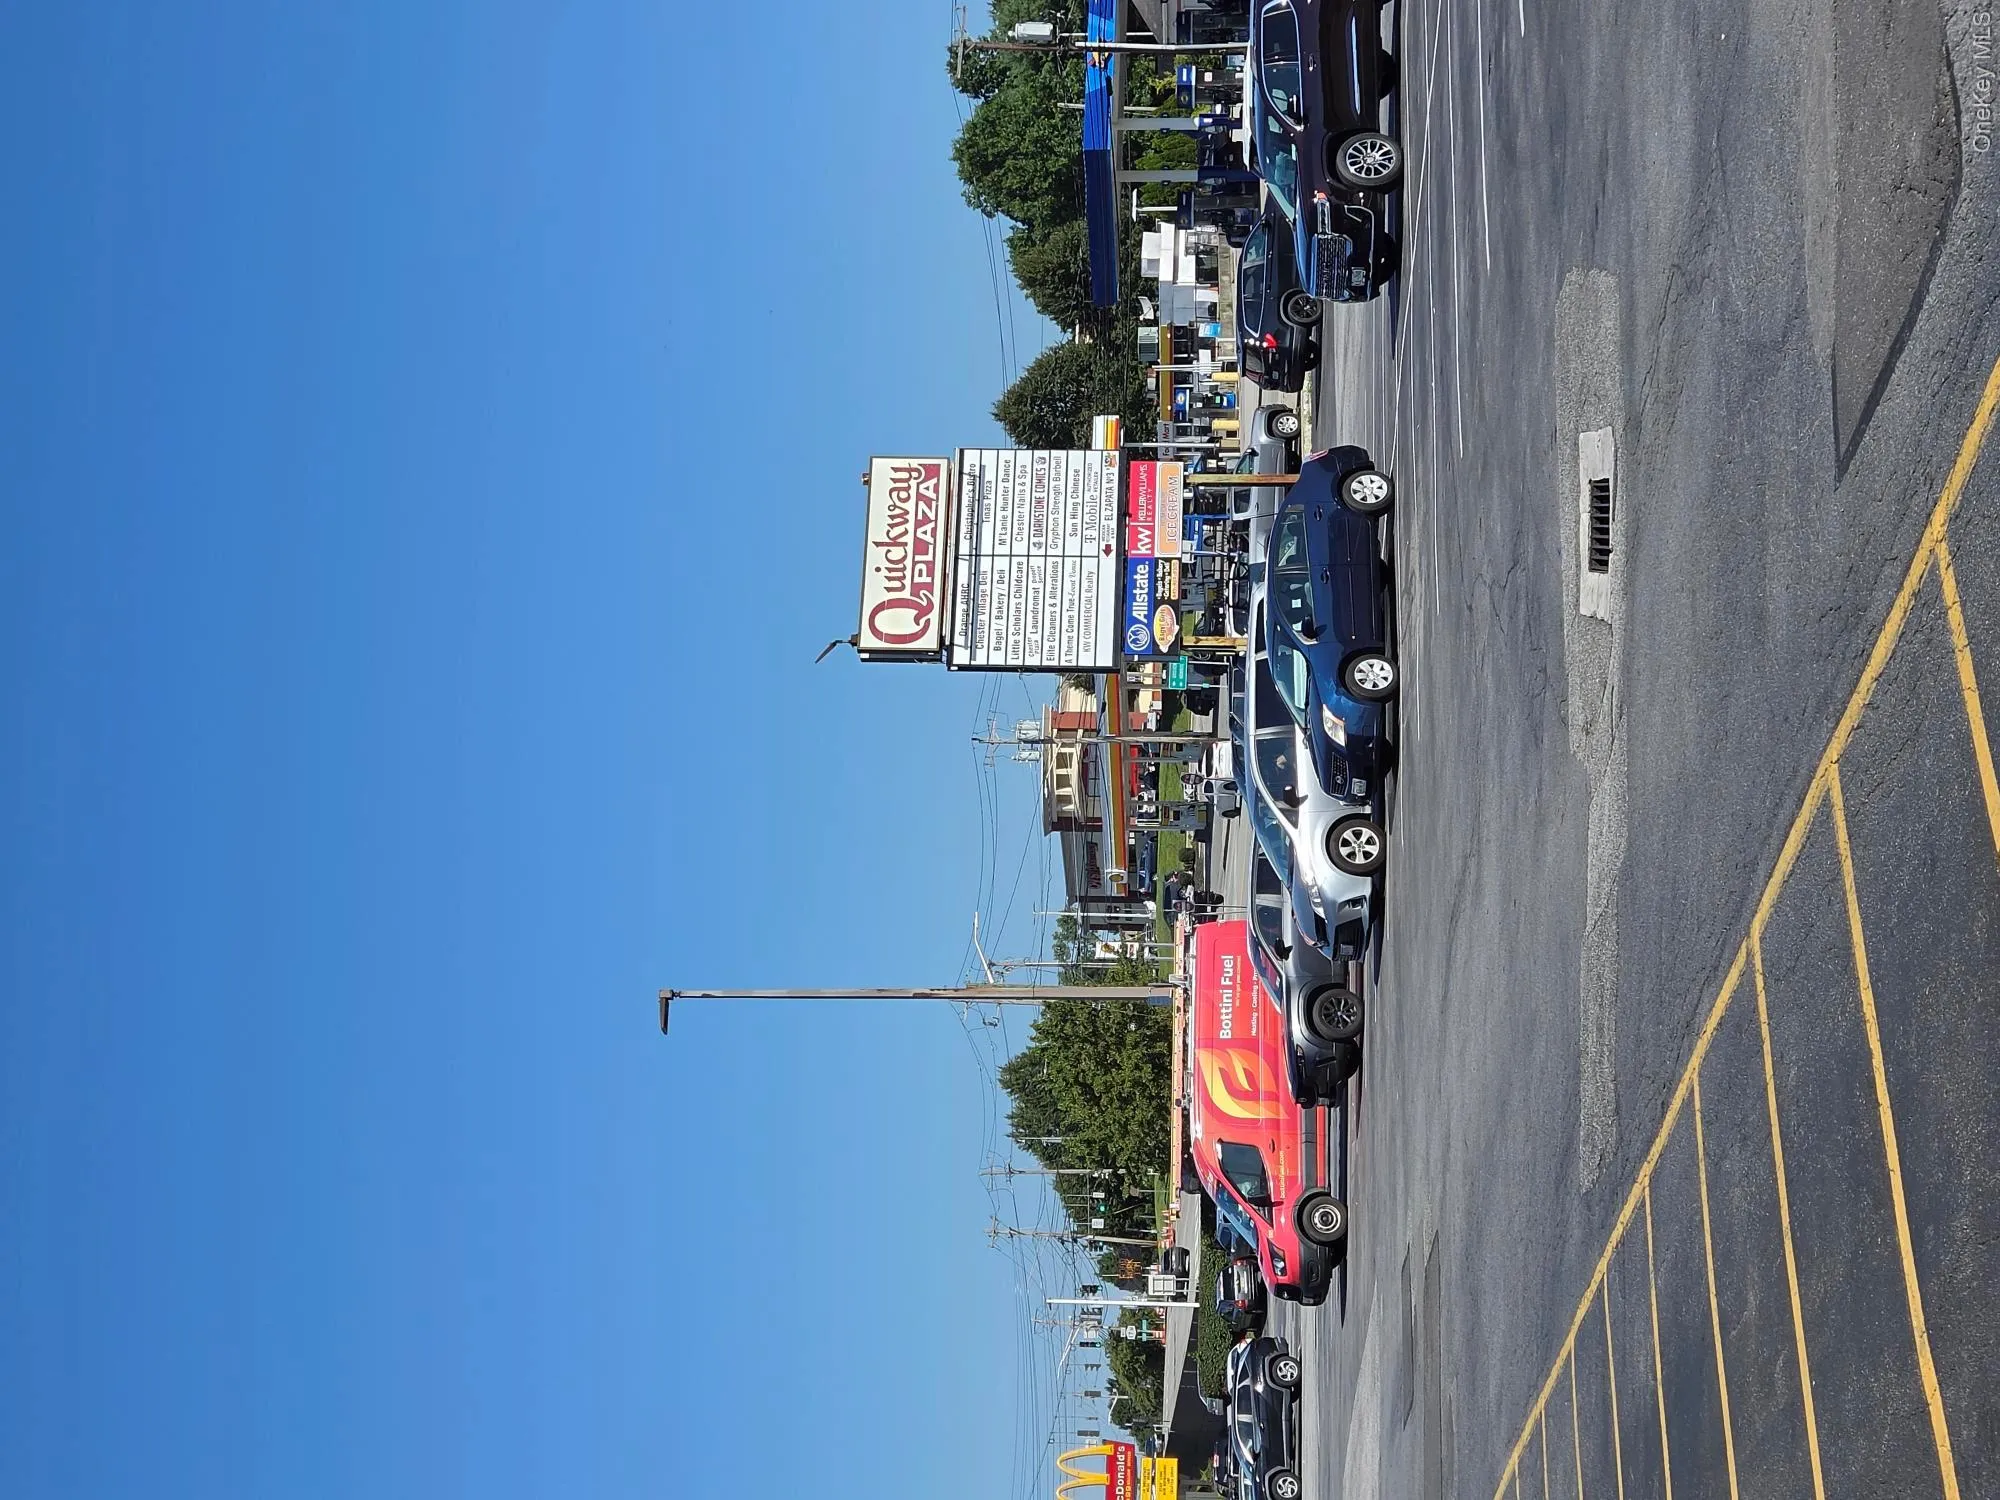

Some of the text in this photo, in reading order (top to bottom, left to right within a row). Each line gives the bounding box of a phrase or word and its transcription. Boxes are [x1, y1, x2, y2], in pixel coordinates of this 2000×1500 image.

[983, 480, 992, 500] Pizza
[1018, 464, 1028, 480] Spa
[998, 459, 1011, 546] M'Lanie Hunter Dance
[1016, 488, 1026, 508] Nails
[1033, 467, 1046, 538] DARKSTONE COMICS
[1050, 456, 1062, 550] Gryphon Strength Barbell
[1069, 468, 1080, 538] Sun Hing Chinese
[1085, 494, 1098, 531] Mobile
[1104, 513, 1113, 521] EL
[1105, 486, 1114, 512] ZAPATA
[1167, 476, 1178, 542] ICE CREAM
[914, 476, 938, 584] PLAZA
[1014, 510, 1024, 542] Chester
[1130, 526, 1152, 554] kw
[868, 462, 934, 644] Quickway
[996, 569, 1006, 584] Deli
[1049, 560, 1058, 600] Alterations
[958, 583, 970, 636] Orange AHRC
[976, 570, 988, 650] Chester Village Deli
[994, 592, 1006, 620] Bakery
[1011, 560, 1024, 660] Little Scholars Childcare
[1030, 587, 1040, 634] Laundromat
[1066, 614, 1074, 633] Come
[1083, 570, 1095, 652] KW COMMERCIAL Realty
[993, 628, 1004, 651] Bagel
[1047, 610, 1057, 642] Cleaners
[1046, 645, 1056, 661] Elite
[1065, 635, 1074, 657] Theme
[1219, 955, 1234, 1039] Bottini Fuel
[1116, 1446, 1125, 1500] cDonald's
